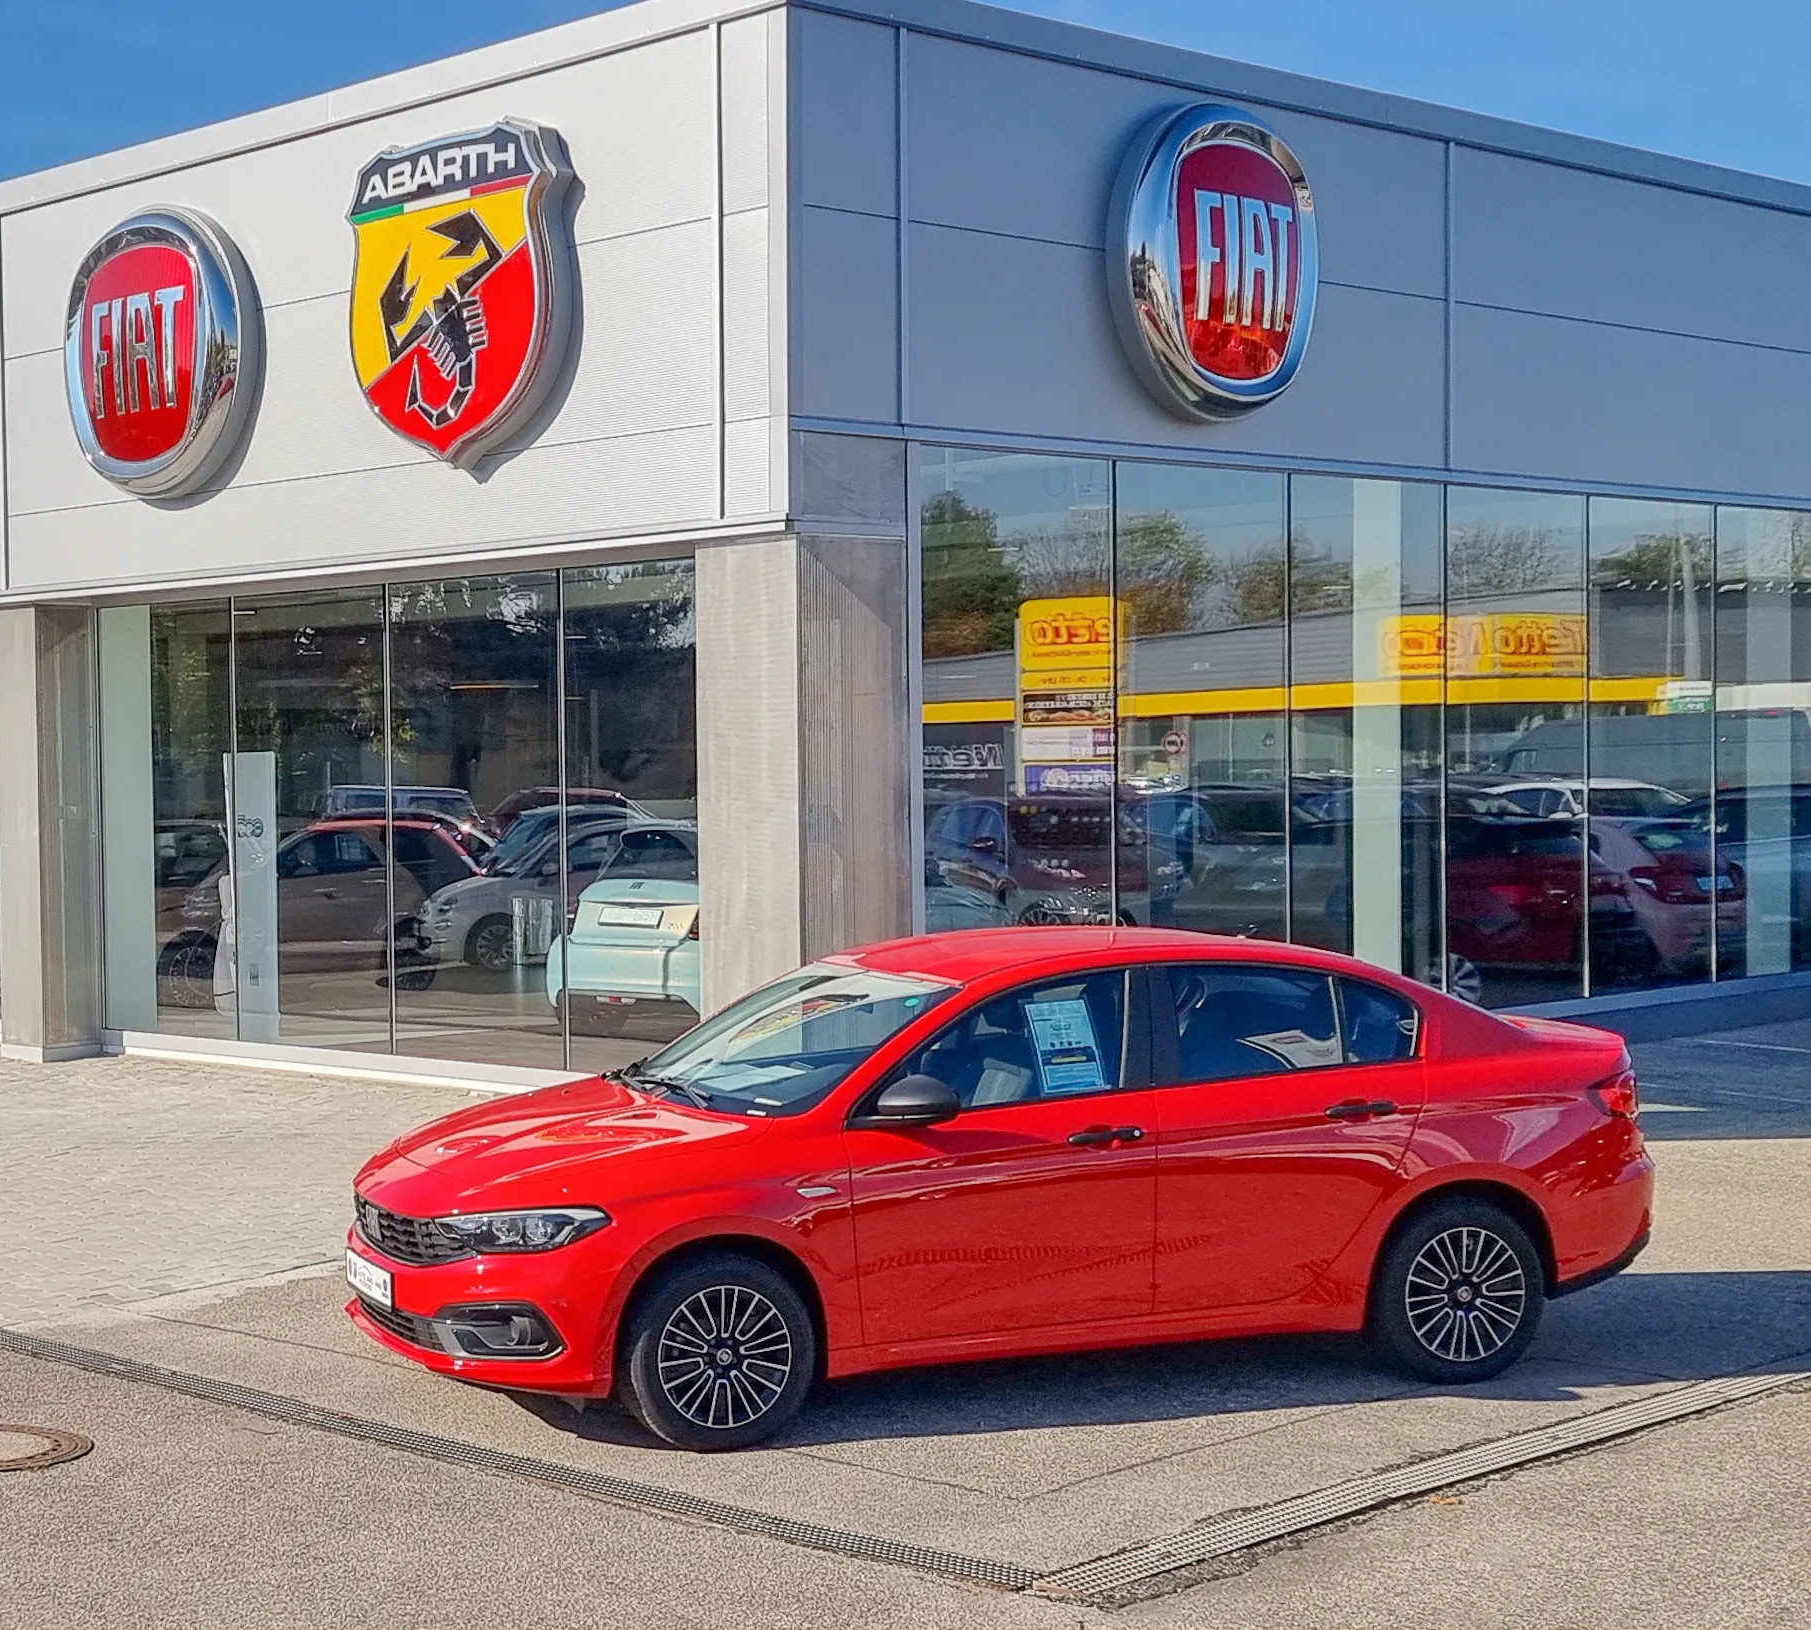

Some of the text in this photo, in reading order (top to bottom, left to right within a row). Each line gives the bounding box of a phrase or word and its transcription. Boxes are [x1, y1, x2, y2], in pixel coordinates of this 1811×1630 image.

[361, 142, 517, 205] ABARTH
[1193, 187, 1294, 332] FIAT
[89, 284, 186, 420] FIAT
